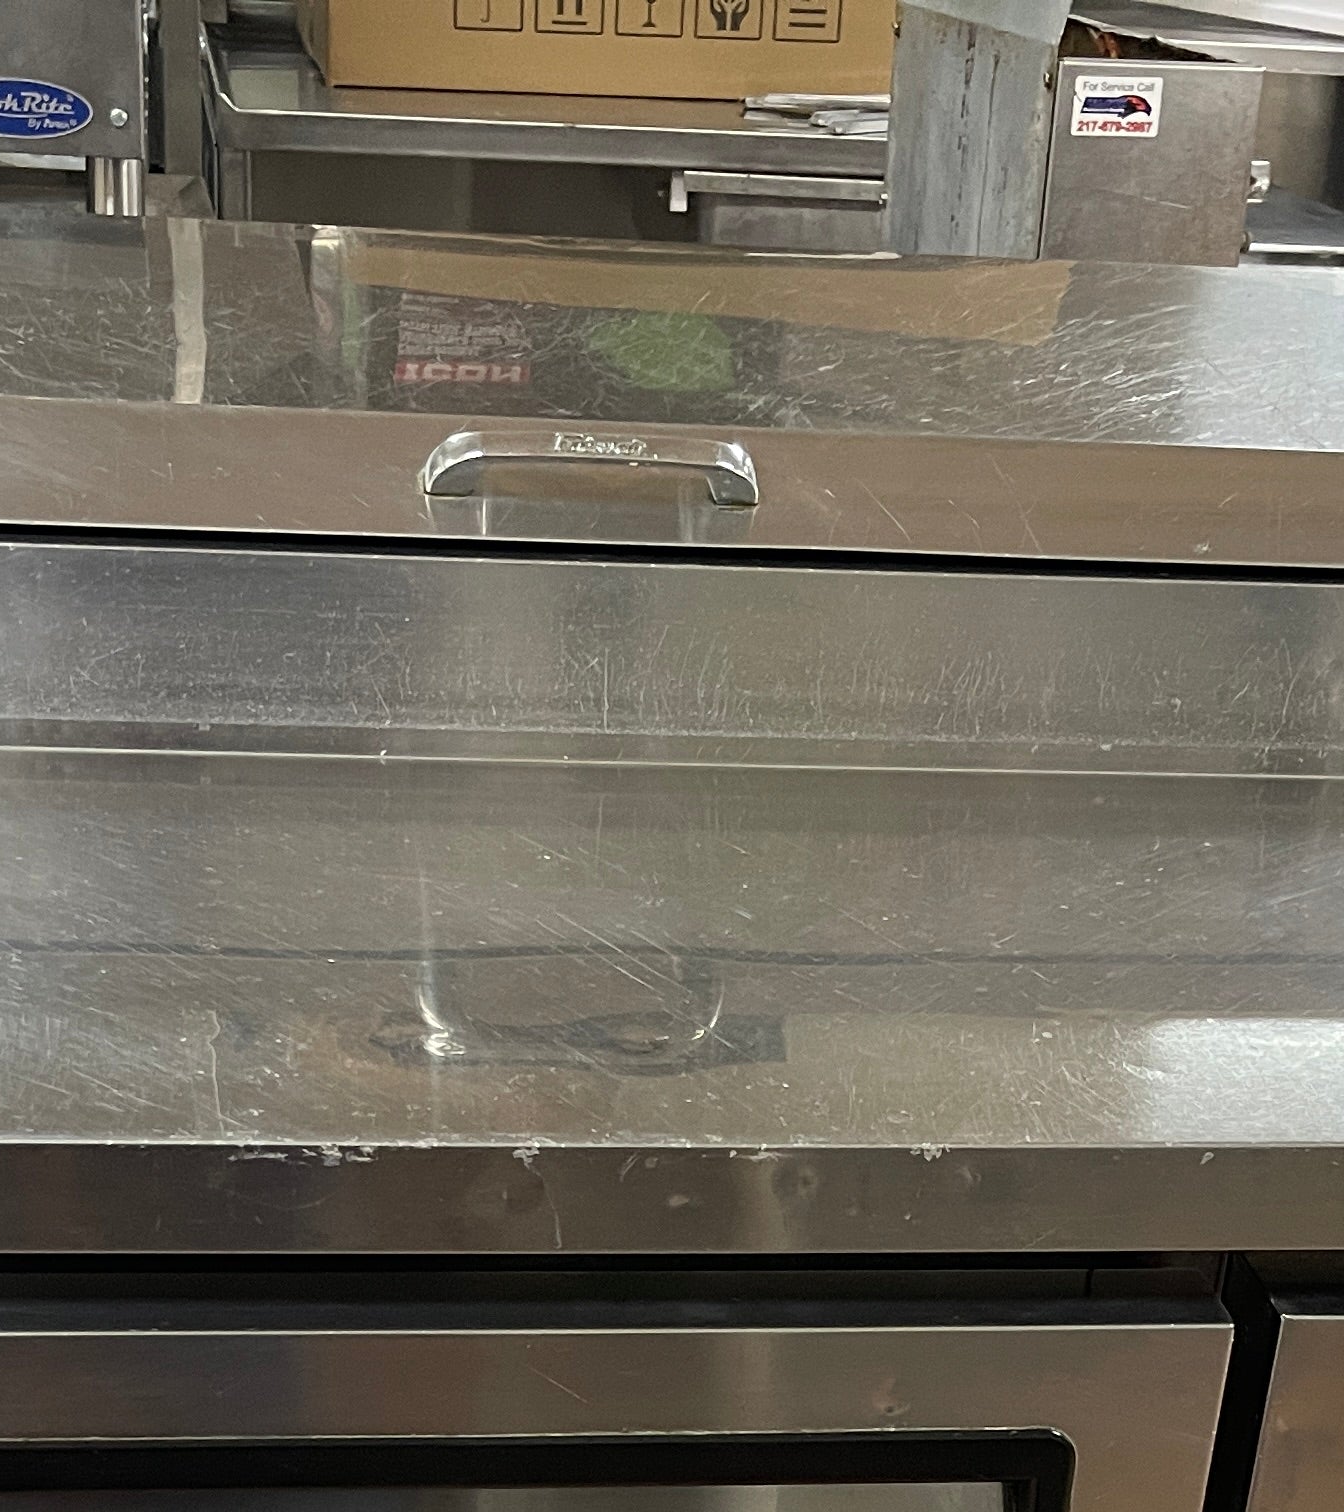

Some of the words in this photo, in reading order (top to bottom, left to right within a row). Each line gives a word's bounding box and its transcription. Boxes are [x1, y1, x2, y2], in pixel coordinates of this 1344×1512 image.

[1083, 82, 1098, 90] For
[1101, 82, 1134, 91] Service
[1137, 82, 1155, 92] Call
